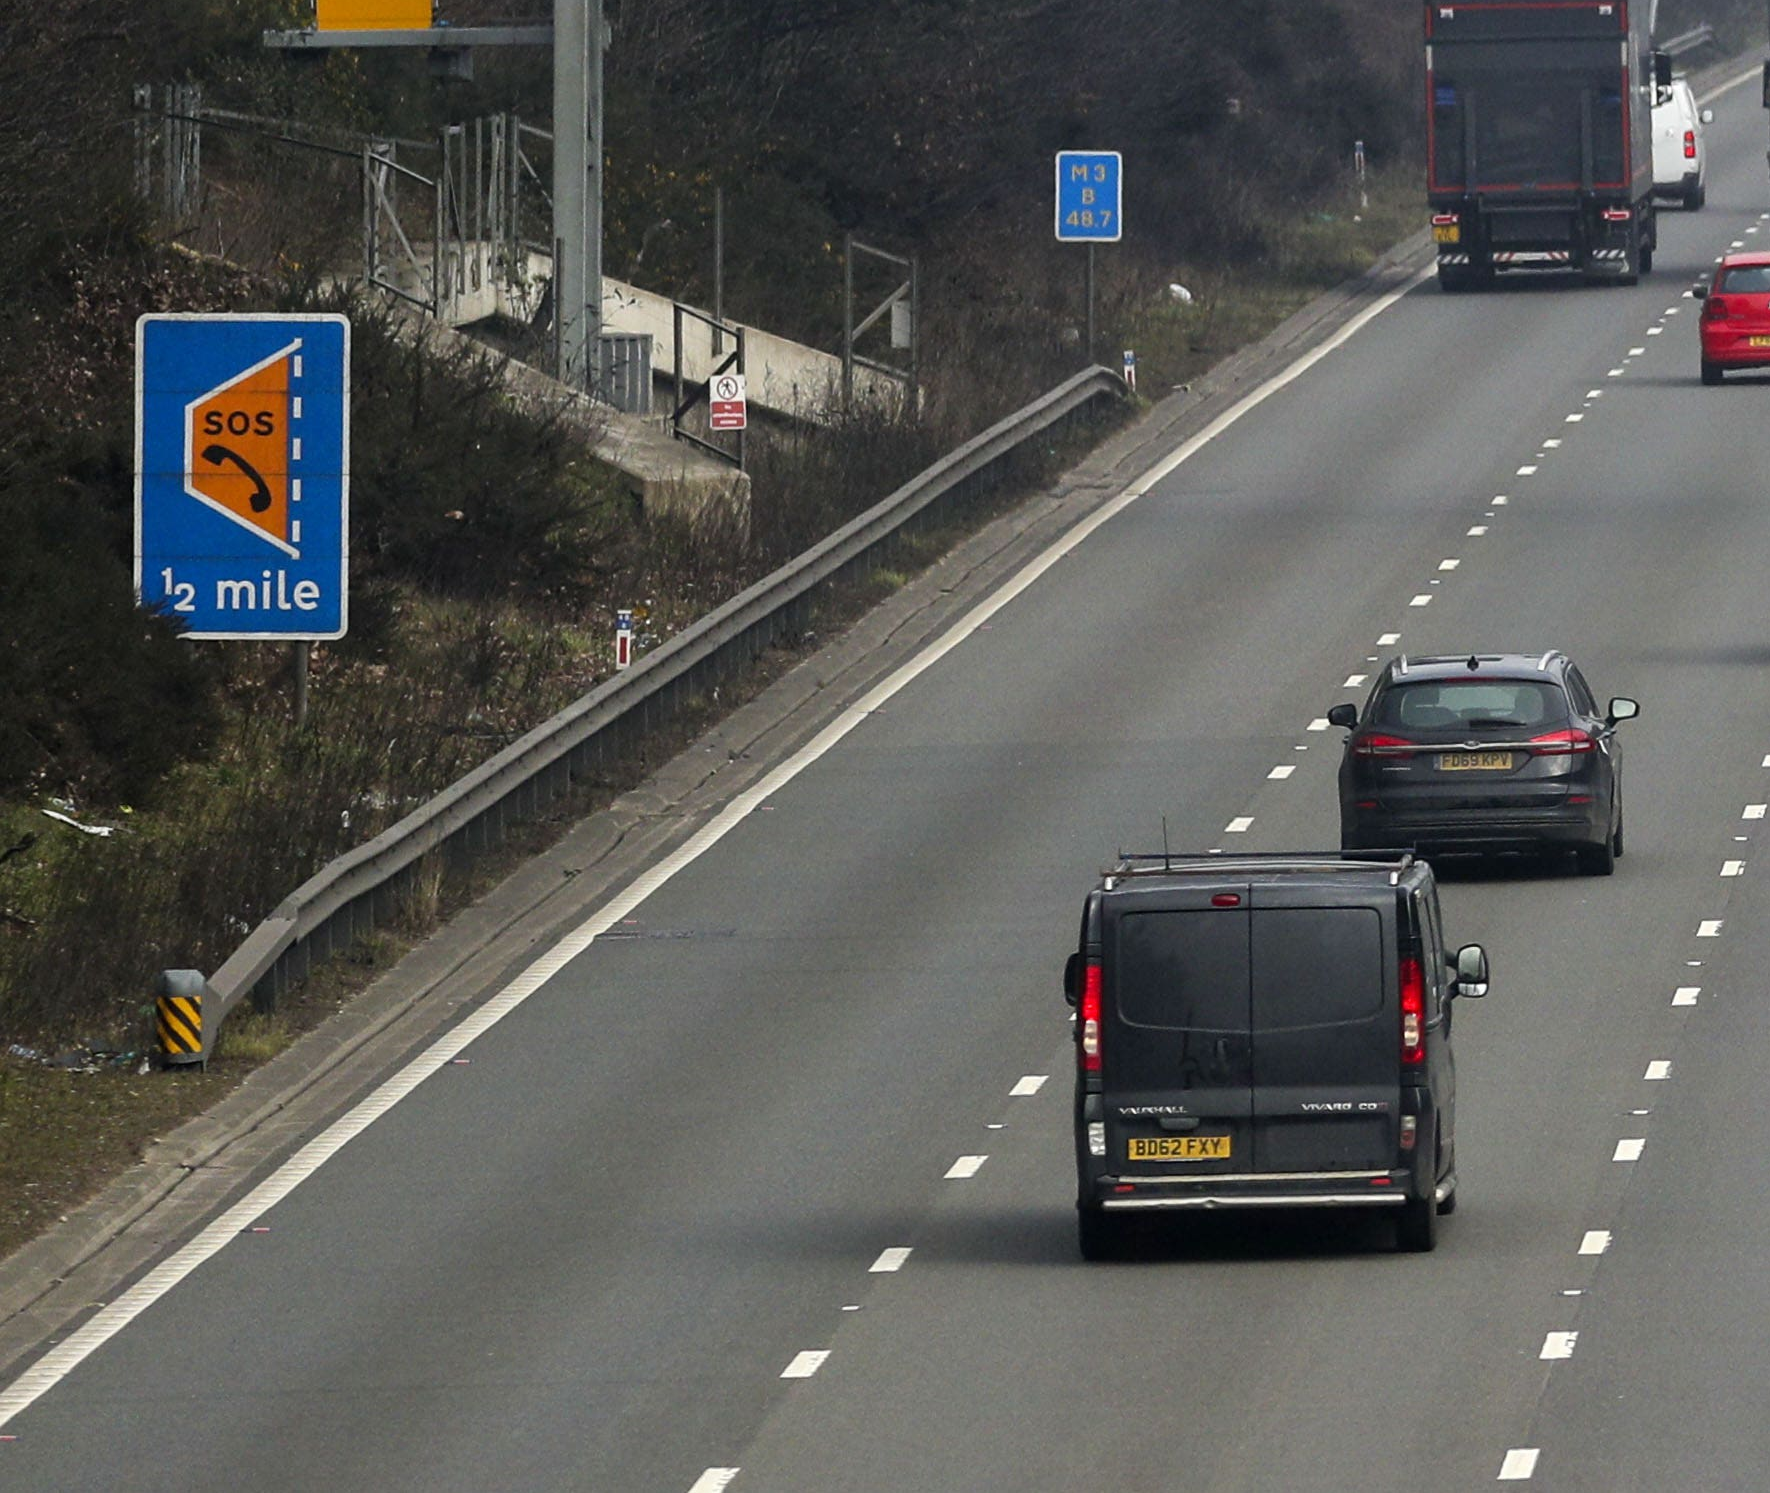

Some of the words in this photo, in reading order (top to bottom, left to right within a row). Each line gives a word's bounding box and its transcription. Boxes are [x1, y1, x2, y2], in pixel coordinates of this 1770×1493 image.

[1082, 188, 1095, 204] B
[203, 411, 274, 436] SOS
[216, 570, 320, 610] mile
[1442, 753, 1479, 767] FD69
[1119, 1106, 1188, 1114] VAUXHALL
[1301, 1102, 1353, 1111] VIVARO
[1136, 1139, 1181, 1156] BD62
[1187, 1138, 1220, 1155] FXY
